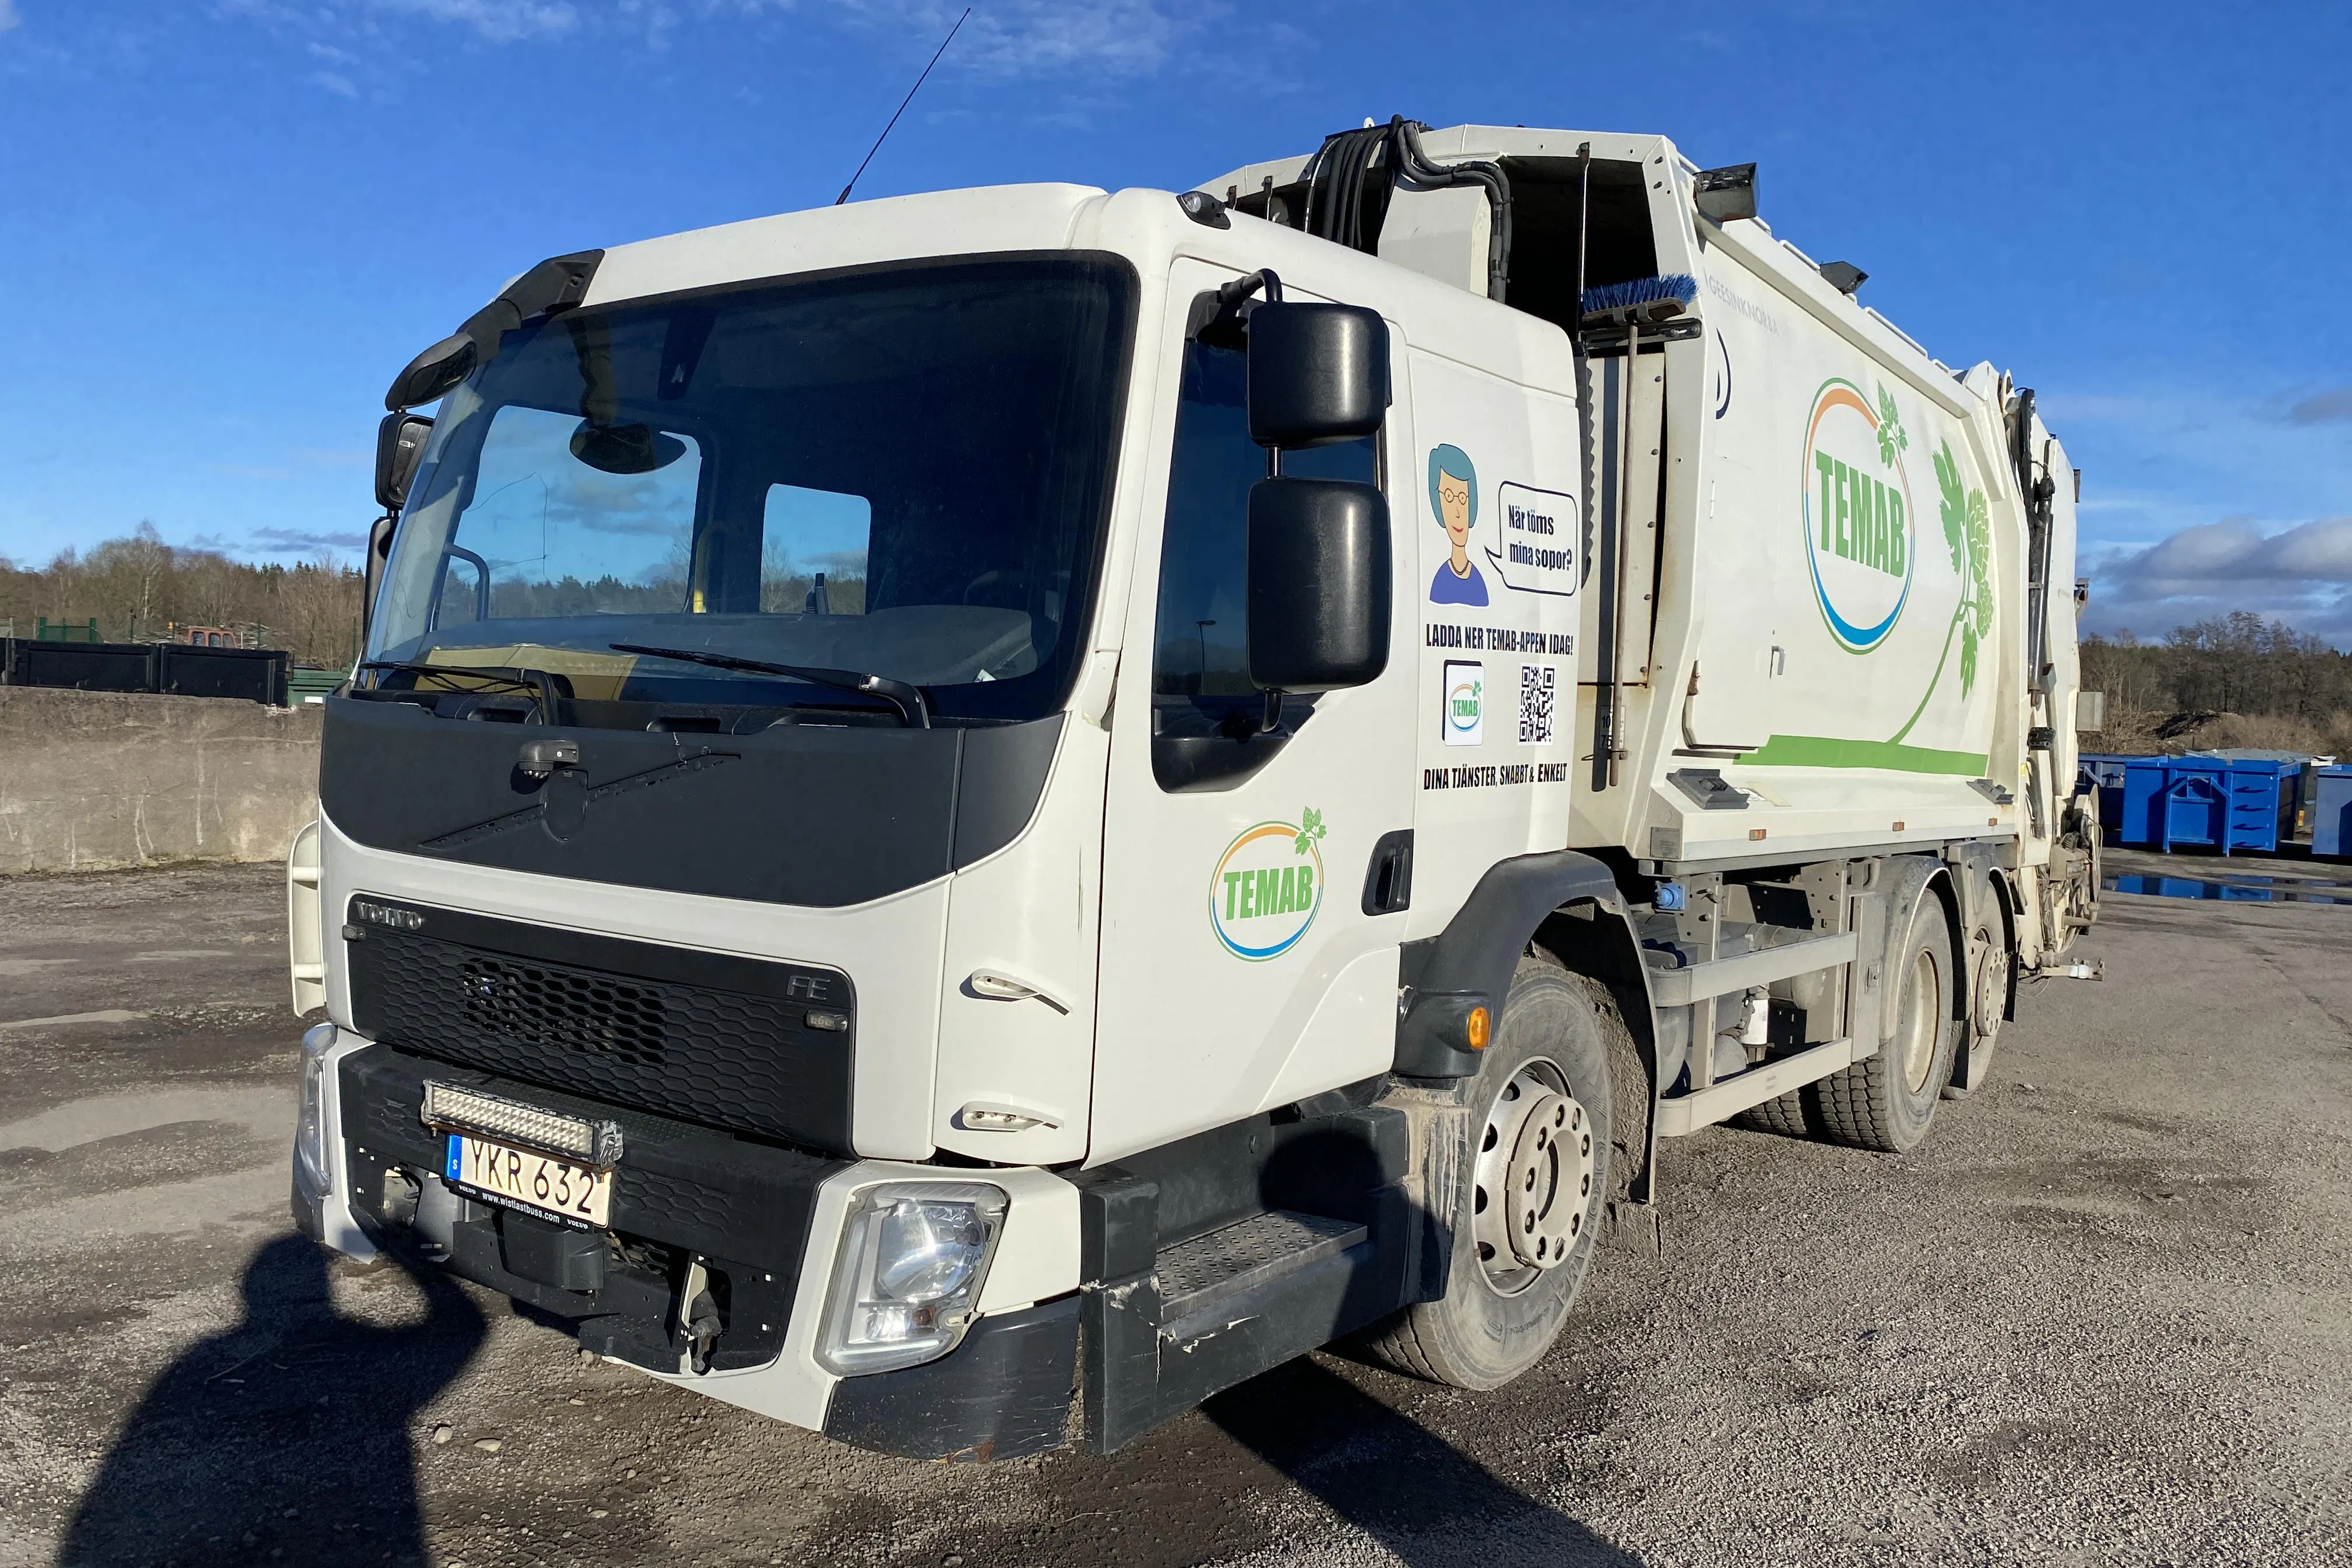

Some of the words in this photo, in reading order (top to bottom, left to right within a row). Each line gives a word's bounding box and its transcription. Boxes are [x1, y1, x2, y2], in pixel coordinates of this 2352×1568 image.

[1709, 275, 1780, 337] GEESINKNORBA
[1508, 504, 1525, 530] När
[1527, 509, 1554, 536] töms
[1815, 449, 1905, 579] TEMAB
[1510, 541, 1533, 566] mina
[1535, 548, 1573, 570] sopor?
[1426, 624, 1462, 648] LADDA
[1465, 626, 1483, 649] NER
[1486, 628, 1546, 653] TEMAB-APPEN
[1549, 634, 1573, 656] IDAG!
[1452, 699, 1478, 717] TEMAB
[1423, 768, 1450, 790] DINA
[1452, 764, 1497, 788] TJÄNSTER,
[1500, 764, 1529, 785] SNABBT
[1529, 766, 1535, 783] &
[1538, 763, 1567, 782] ENKELT
[1224, 865, 1314, 921] TEMAB
[355, 901, 422, 930] VOLVO
[785, 975, 831, 1000] FE
[452, 1159, 458, 1170] S
[471, 1138, 523, 1194] YKR
[533, 1160, 592, 1214] 632
[459, 1185, 477, 1195] VOLVO
[482, 1192, 560, 1224] www.wistlastbuss.com
[566, 1219, 589, 1230] VOLVO
